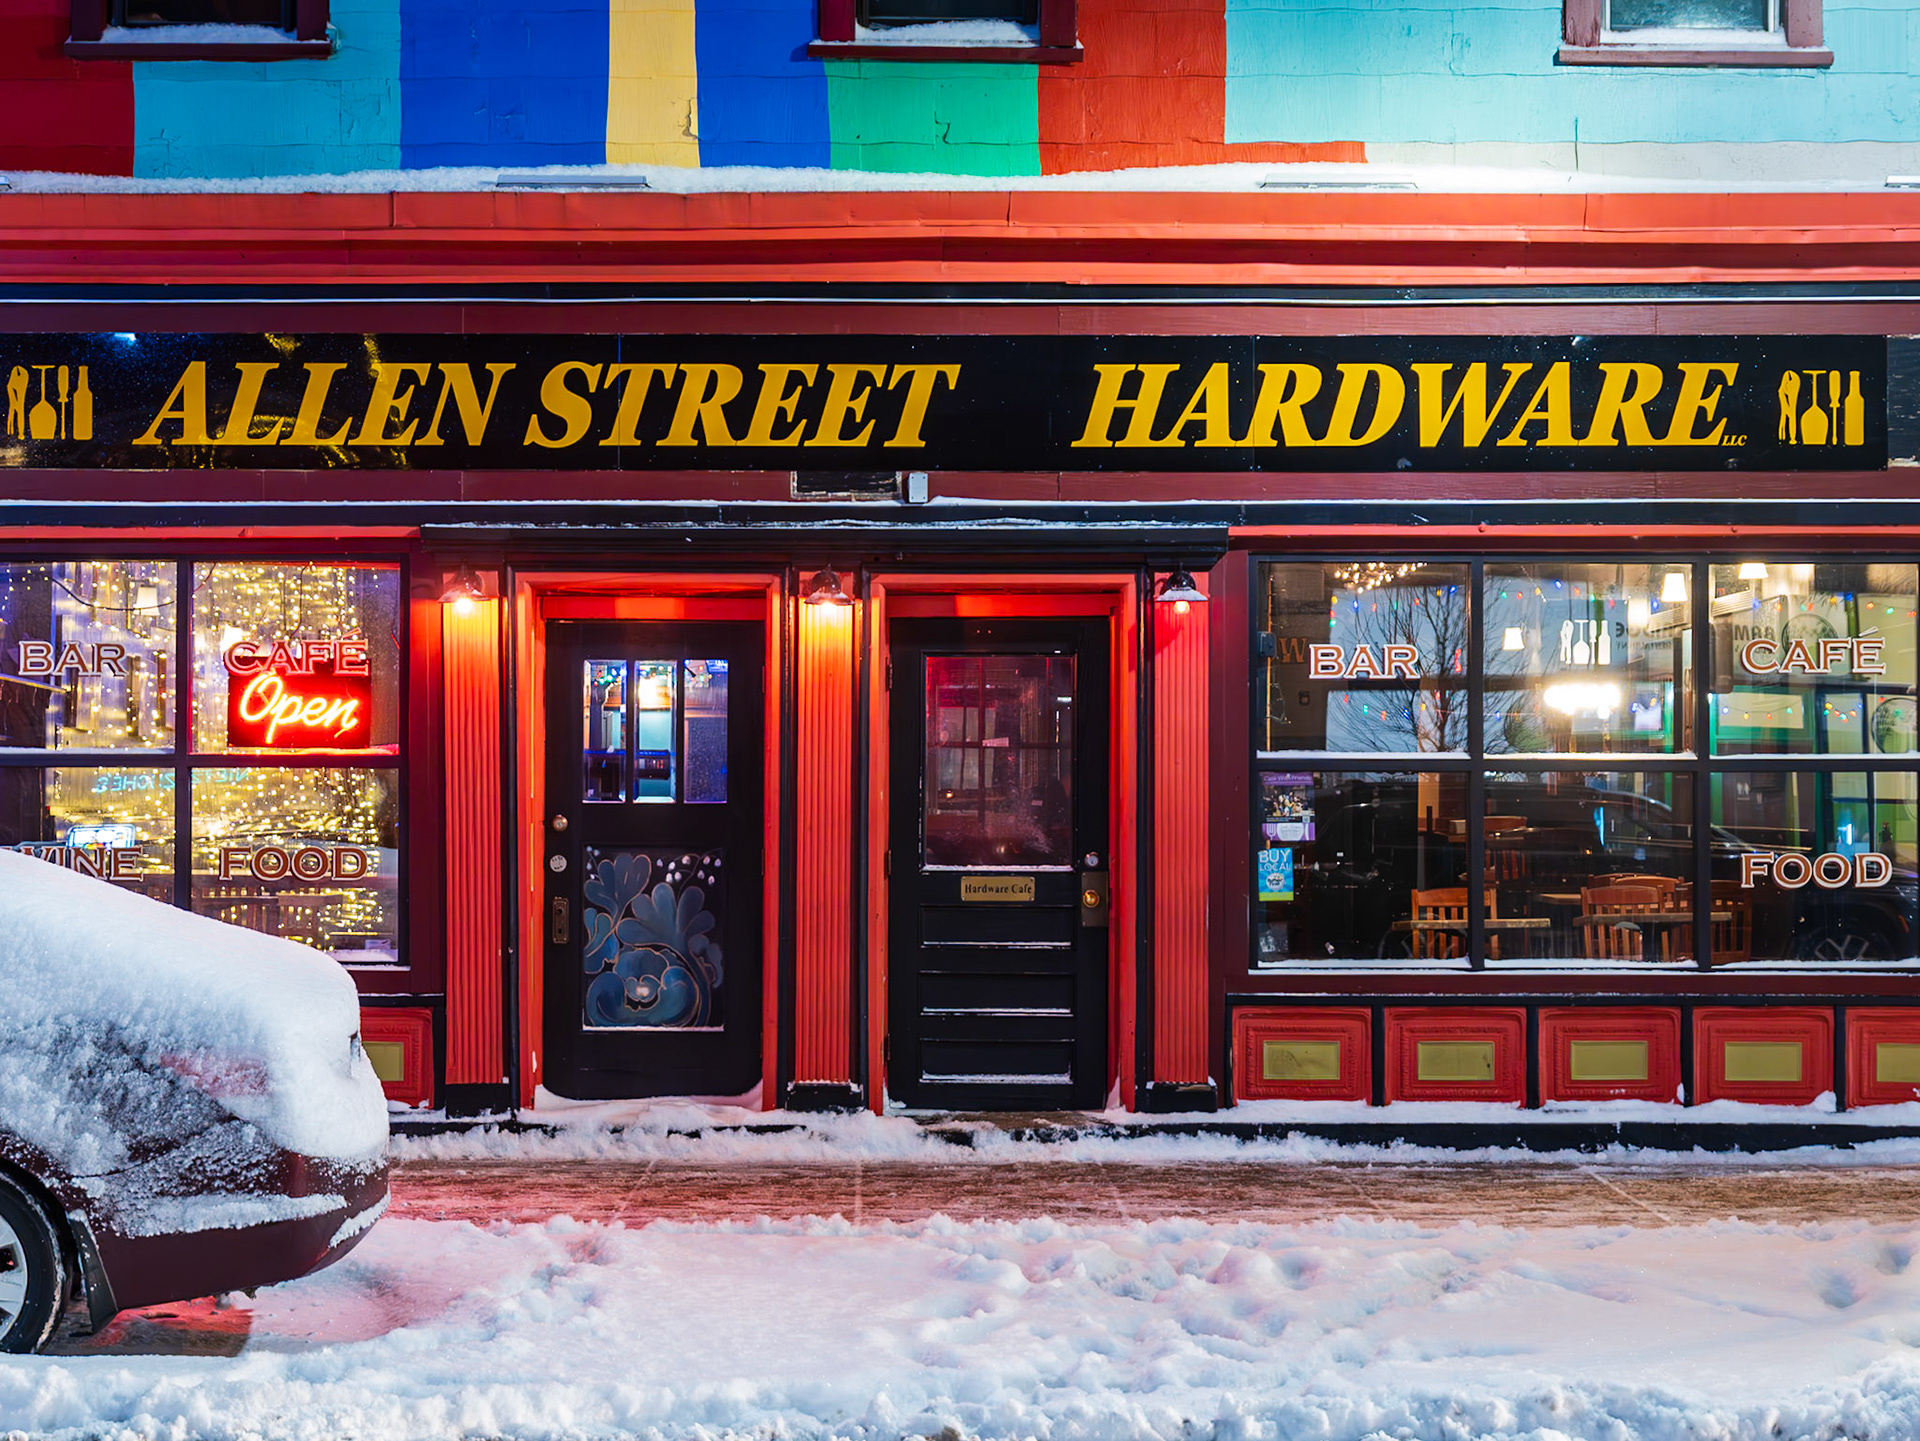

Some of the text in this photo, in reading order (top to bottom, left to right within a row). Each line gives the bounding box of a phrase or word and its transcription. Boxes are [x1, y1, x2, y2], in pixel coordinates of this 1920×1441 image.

[131, 361, 961, 448] ALLEN STREET
[1070, 361, 1748, 448] HARDWARE LLC
[18, 640, 128, 677] BAR
[223, 629, 369, 676] CAFÉ
[1308, 643, 1421, 681] BAR
[1740, 625, 1887, 675] CAFÉ
[238, 674, 360, 744] Open
[0, 846, 144, 882] INE
[219, 846, 368, 881] FOOD
[1259, 849, 1291, 863] BUY
[1259, 862, 1291, 872] LOCAL
[1740, 852, 1893, 890] FOOD
[964, 883, 1032, 894] Hardware Cafe
